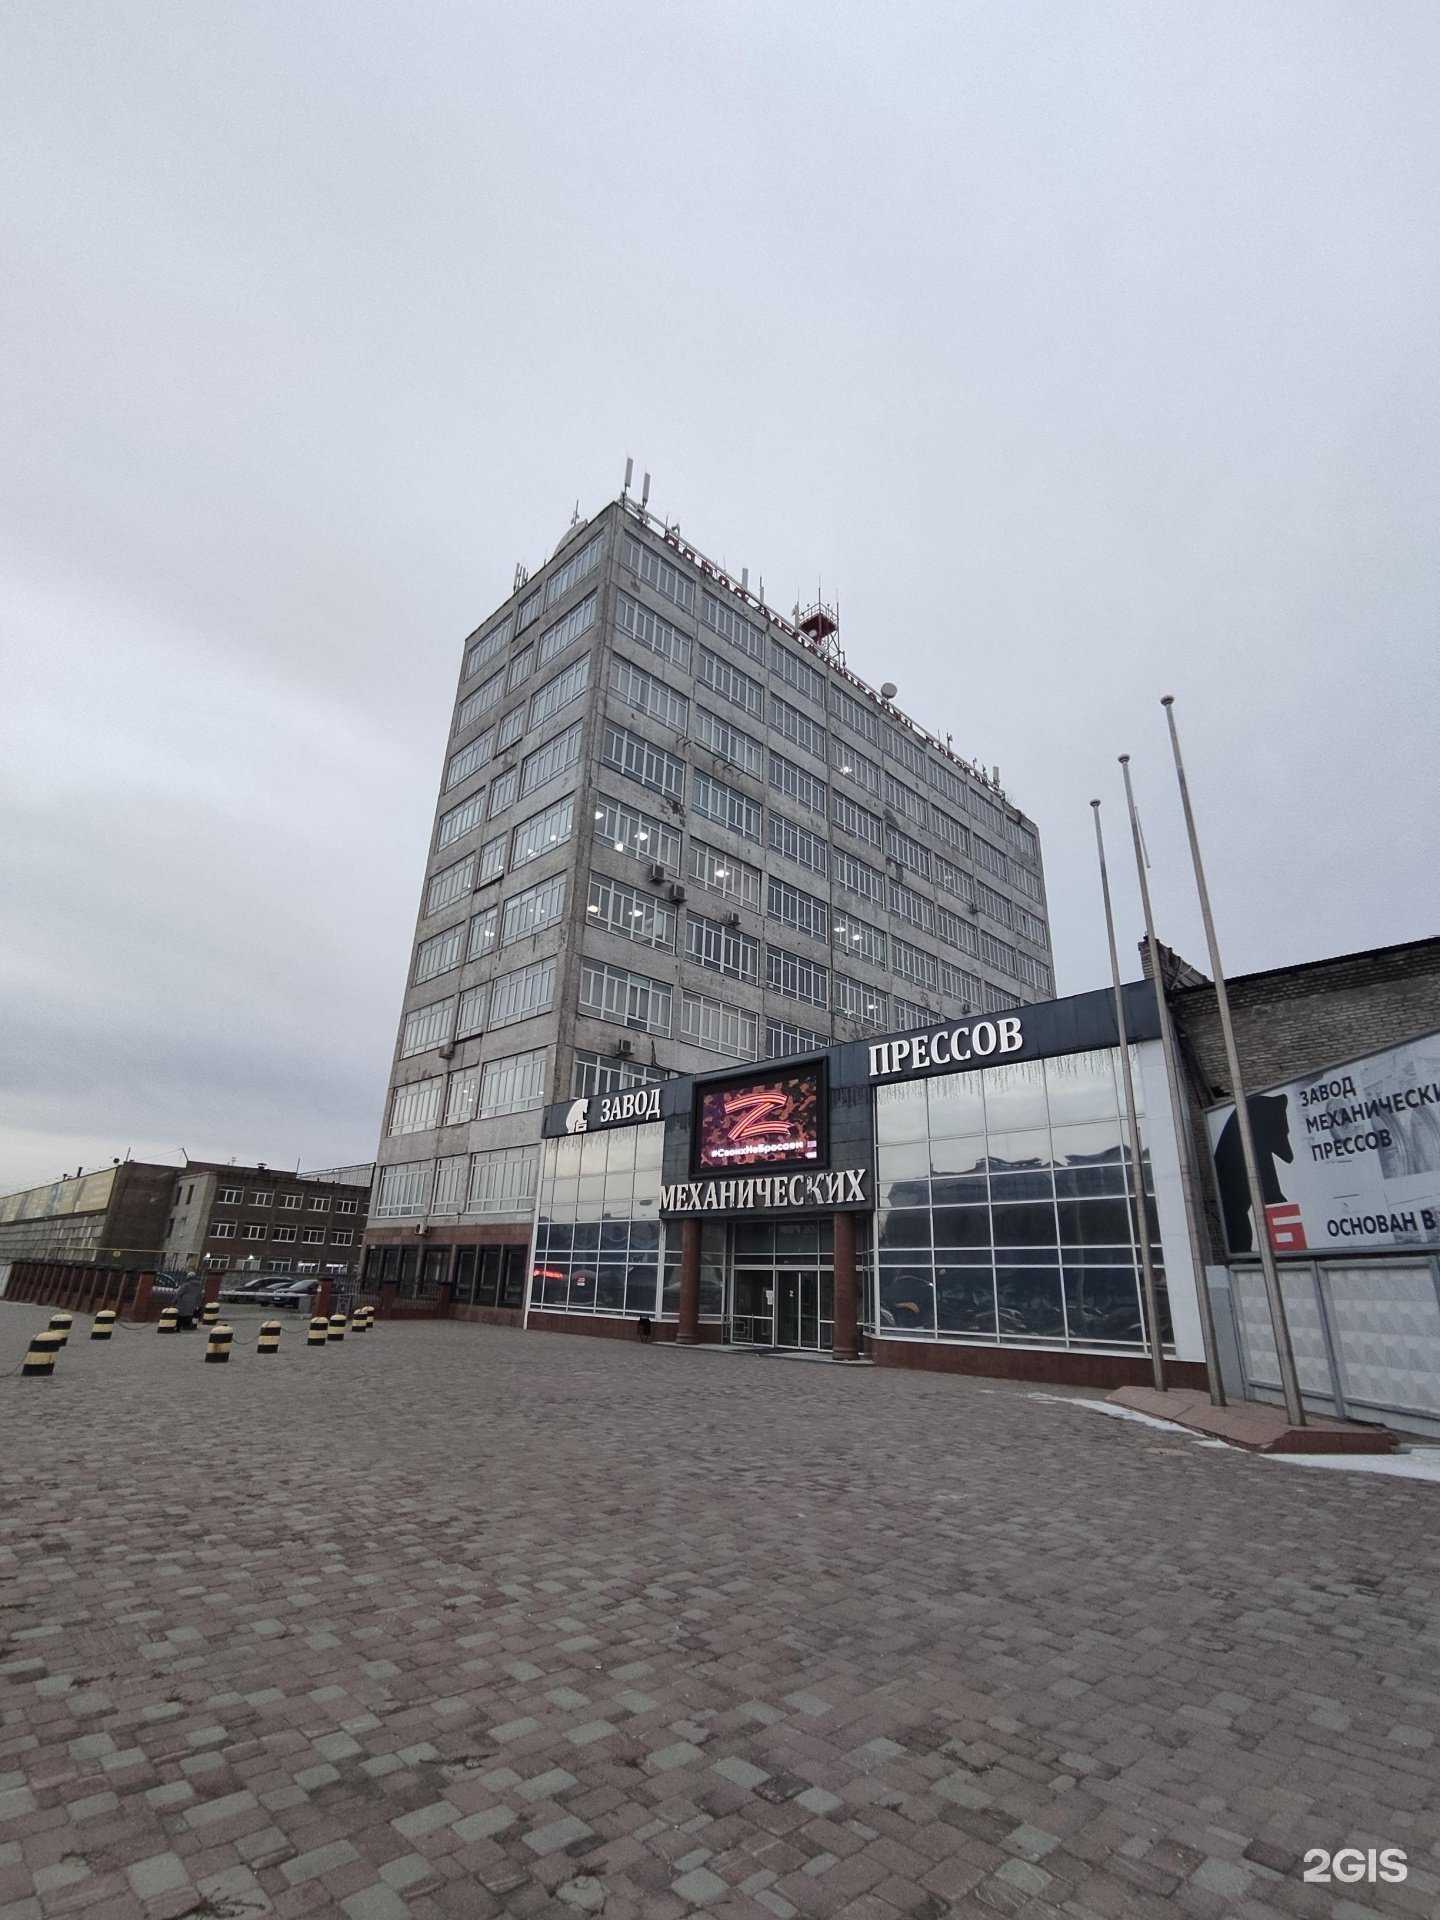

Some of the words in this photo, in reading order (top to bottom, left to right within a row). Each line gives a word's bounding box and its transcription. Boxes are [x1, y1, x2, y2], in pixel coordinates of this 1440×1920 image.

[868, 1016, 1024, 1077] ПРЕССОВ
[600, 1087, 661, 1123] ЗАВОД
[1299, 1076, 1357, 1107] ЗАВОД
[1311, 1128, 1393, 1162] ПРЕССОВ
[659, 1168, 866, 1212] МЕХАНИЧЕСКИХ
[1327, 1211, 1418, 1237] ОСНОВАН
